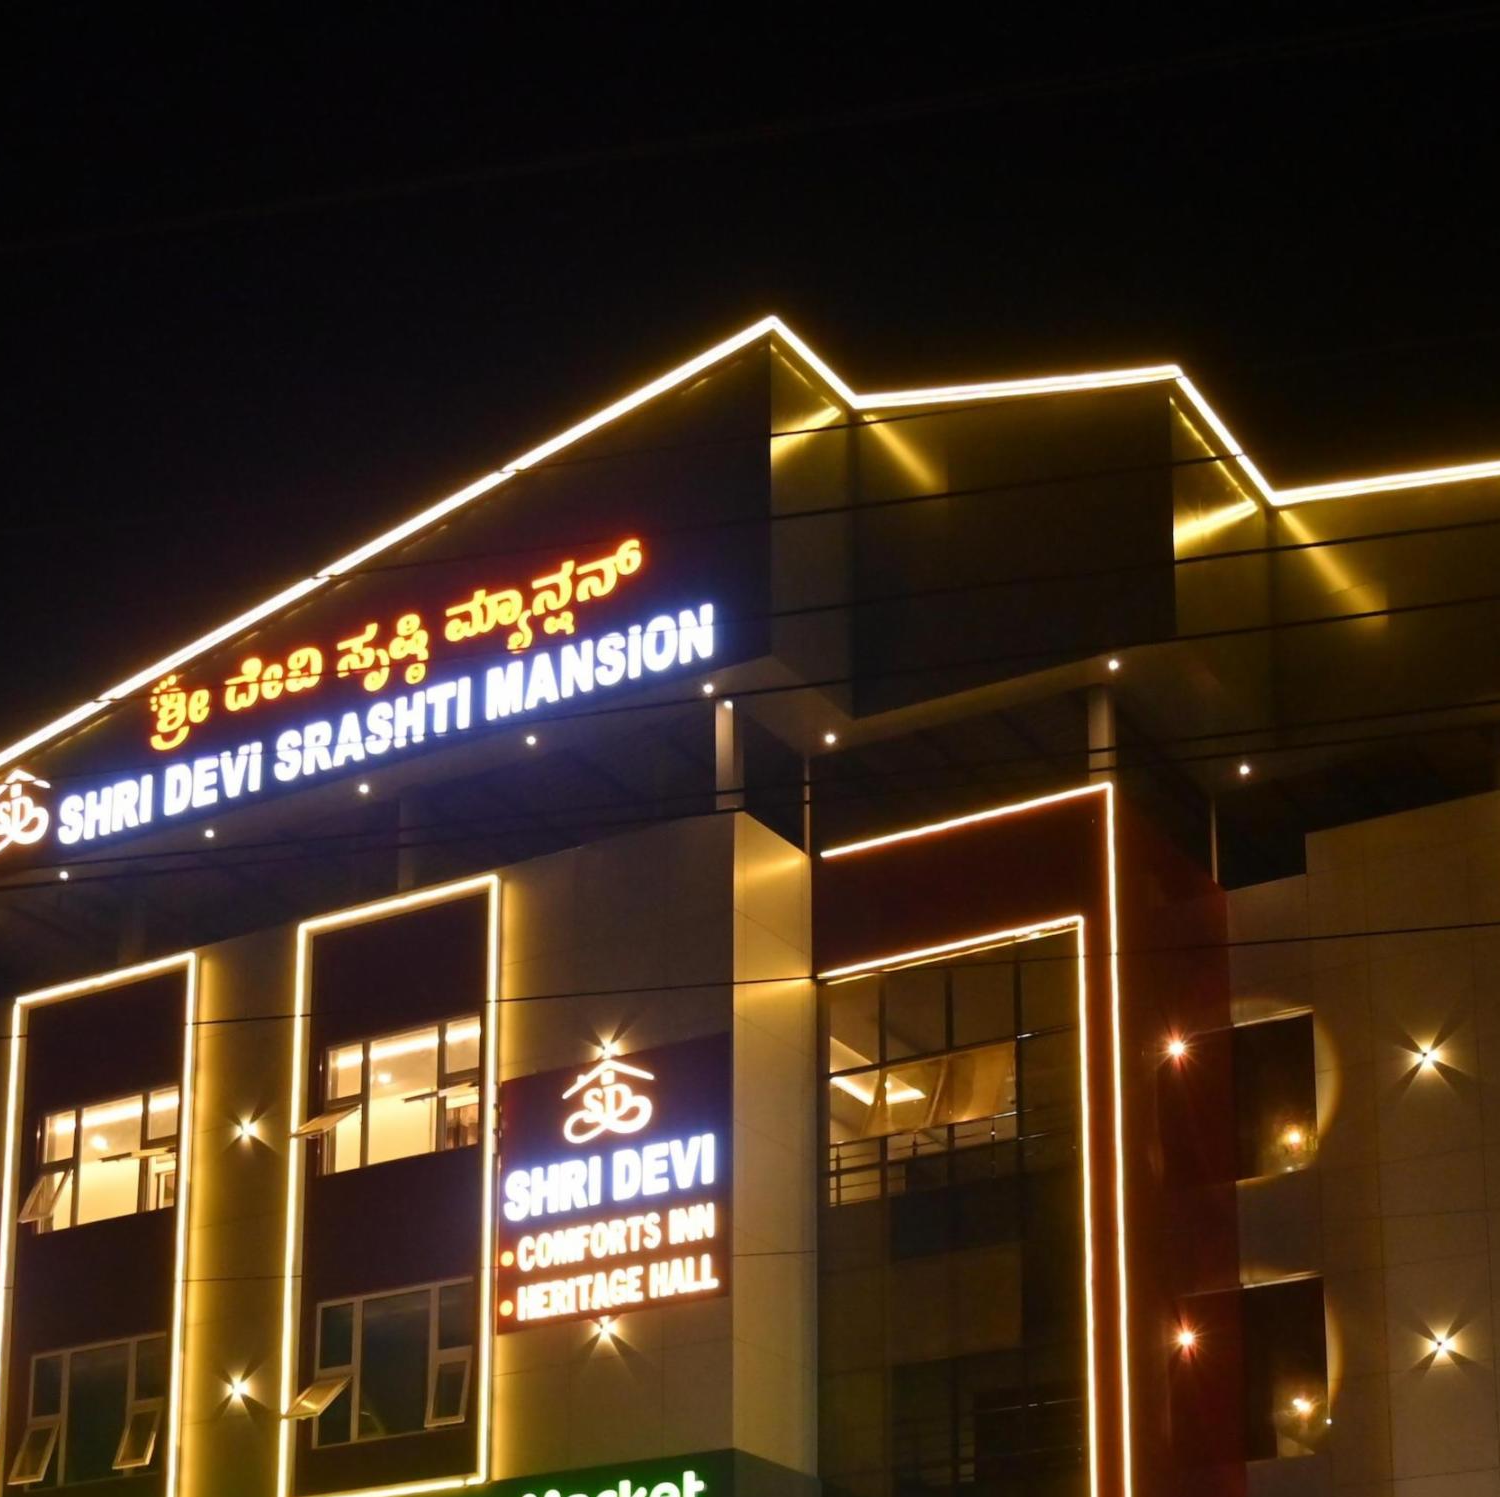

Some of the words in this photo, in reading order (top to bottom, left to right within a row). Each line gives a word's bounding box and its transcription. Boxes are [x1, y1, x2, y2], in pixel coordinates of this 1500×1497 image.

[58, 774, 153, 845] SHRI
[163, 742, 262, 816] DEVI
[274, 676, 470, 782] SRASHTI
[485, 603, 714, 721] MANSION
[150, 674, 210, 751] ಶ್ರೀ
[224, 647, 323, 711] ದೇವಿ
[503, 1155, 601, 1222] SHRI
[613, 1133, 716, 1201] DEVI
[517, 1211, 662, 1272] COMFORTS
[669, 1202, 715, 1246] INN
[517, 1265, 644, 1321] HERITAGE
[649, 1253, 719, 1299] HALL
